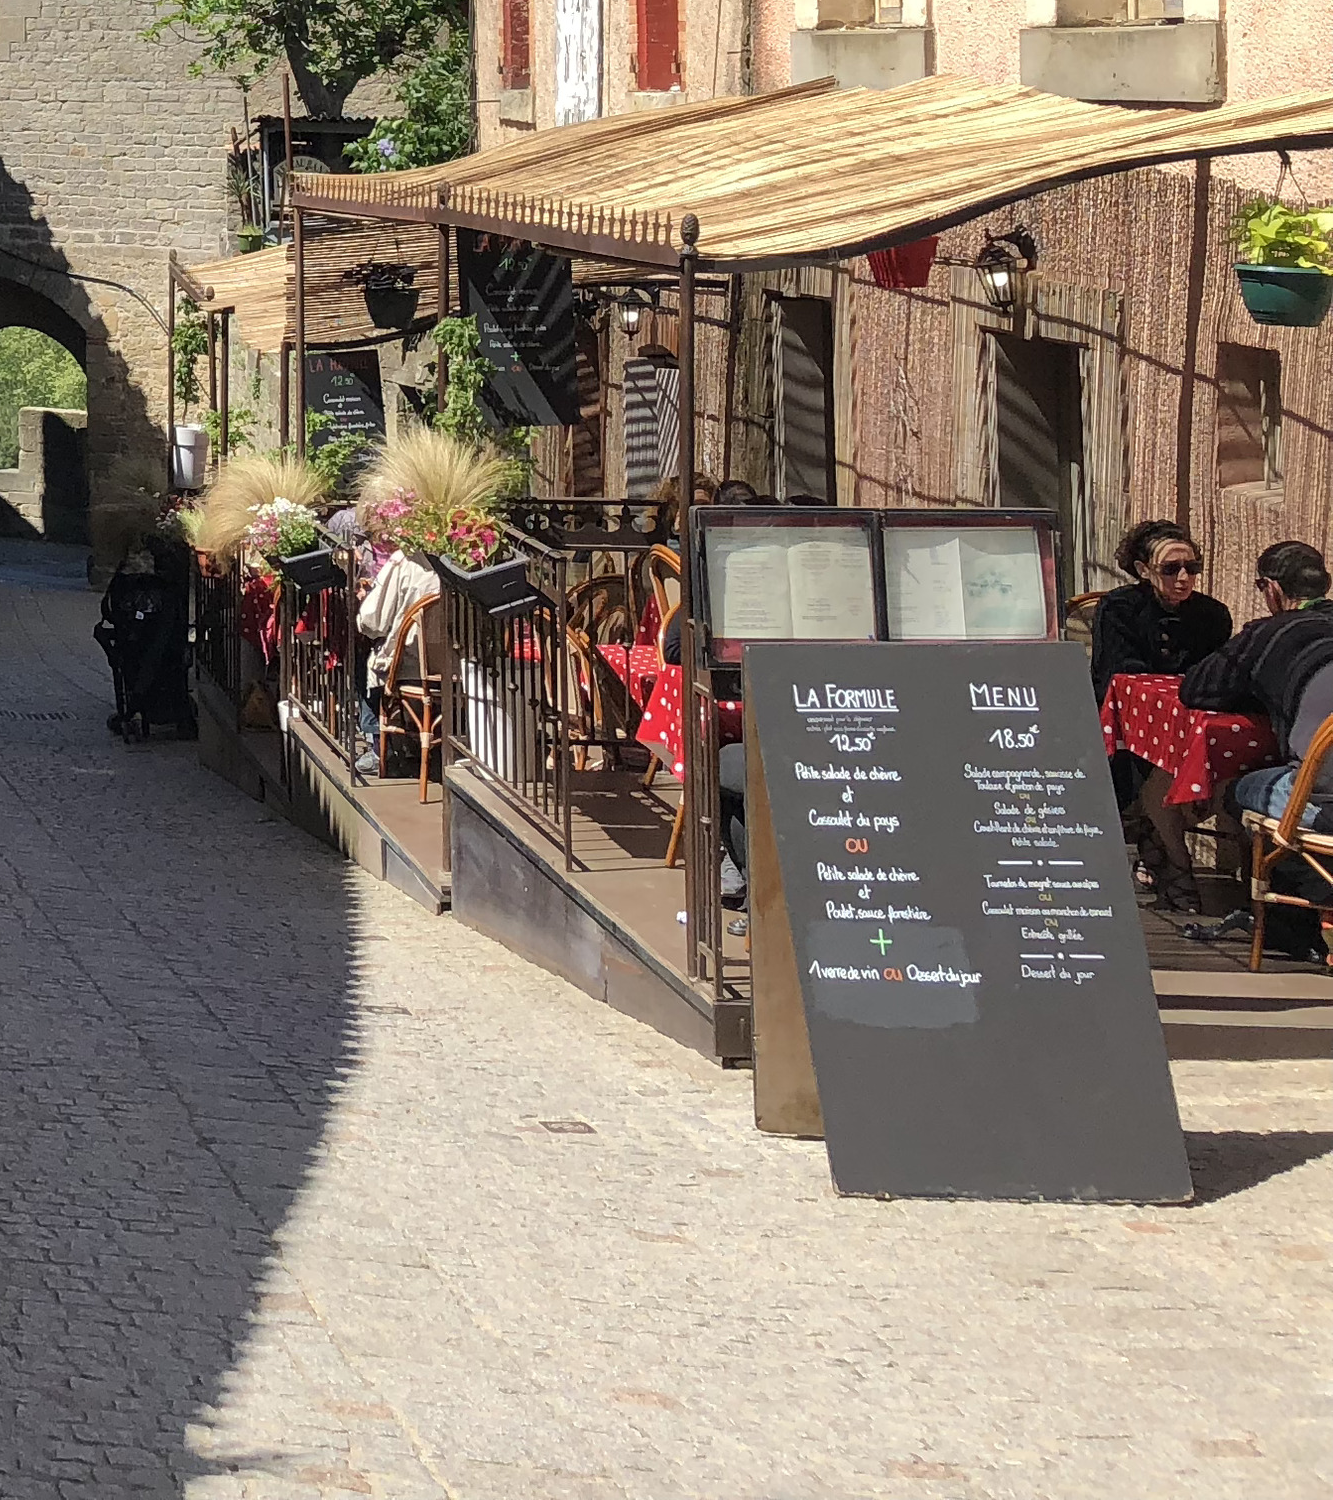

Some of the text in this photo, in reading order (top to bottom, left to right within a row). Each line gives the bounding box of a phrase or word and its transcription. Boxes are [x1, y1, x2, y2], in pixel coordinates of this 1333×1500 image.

[793, 684, 897, 709] LA FORMULE
[969, 682, 1037, 707] MENU
[794, 761, 902, 781] Petite salade de chèvre
[841, 785, 854, 803] et
[808, 808, 900, 833] Cassoulet du pays
[816, 861, 846, 881] Petite
[847, 865, 875, 881] salade
[876, 867, 888, 881] de
[858, 884, 872, 900] et
[847, 966, 860, 980] de
[860, 964, 880, 980] vin
[947, 968, 961, 982] du
[958, 972, 983, 987] jour
